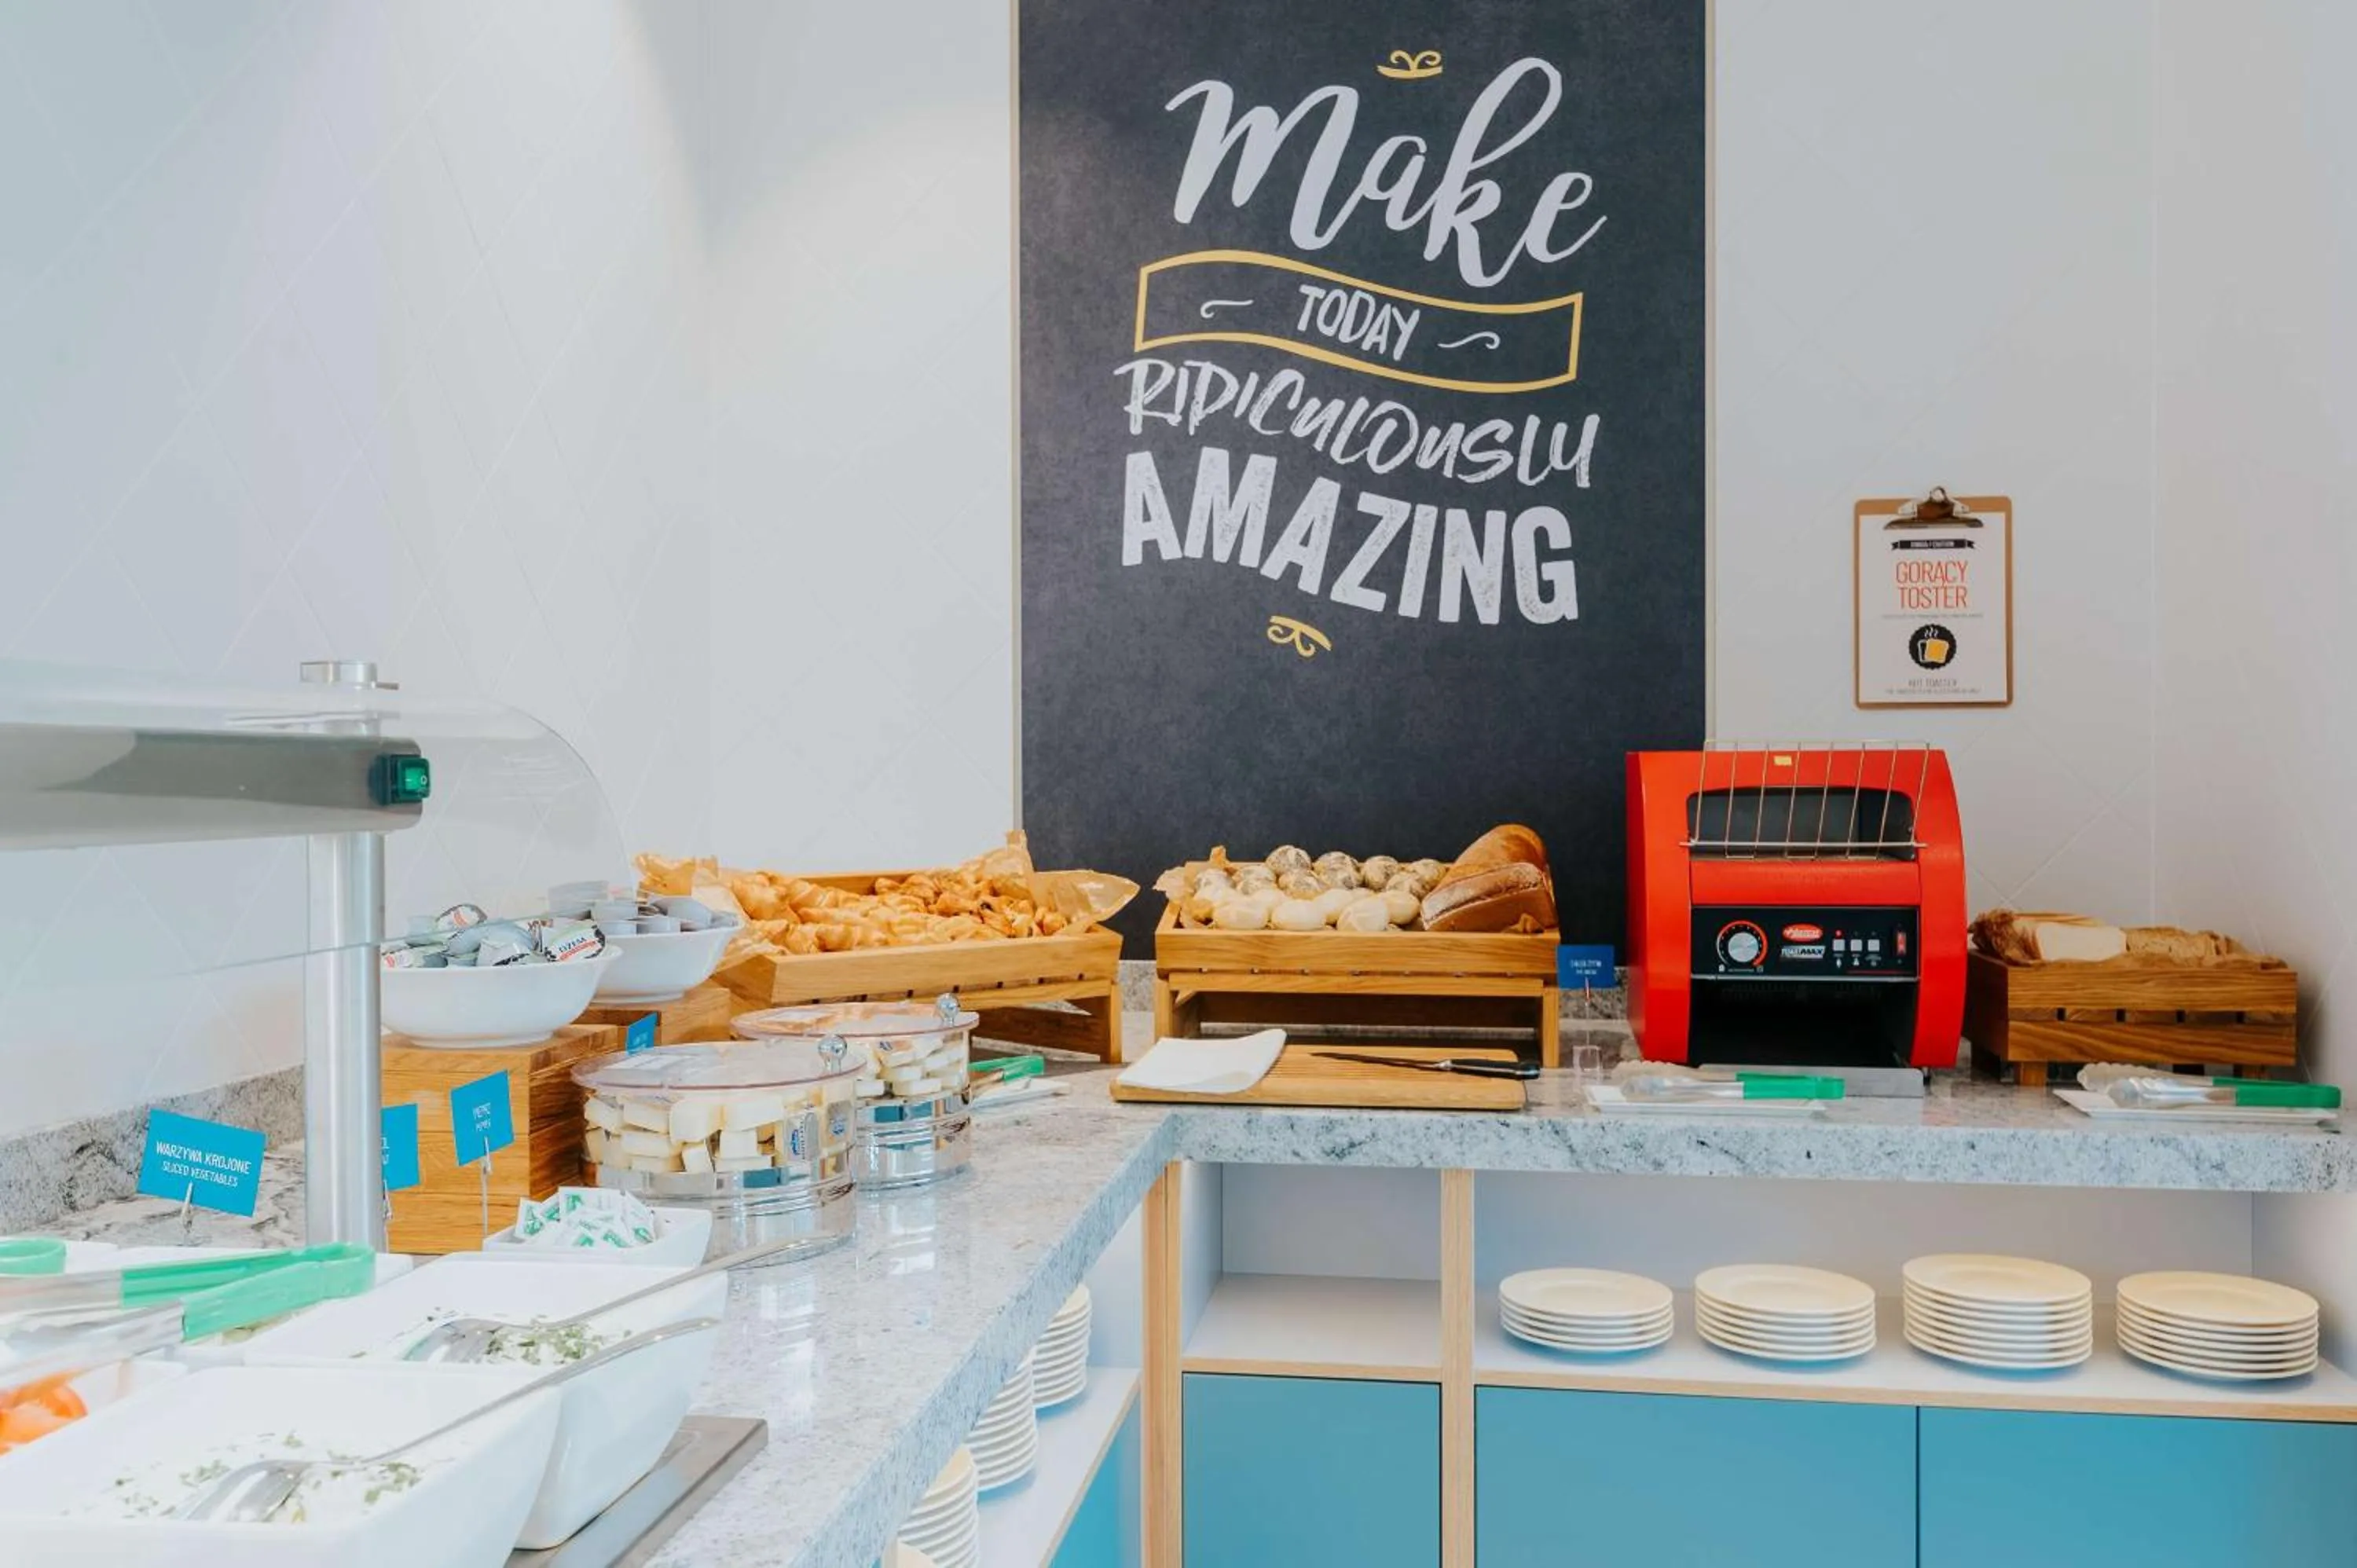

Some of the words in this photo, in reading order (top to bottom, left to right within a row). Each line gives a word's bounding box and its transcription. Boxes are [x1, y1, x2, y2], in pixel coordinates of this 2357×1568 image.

[1165, 58, 1606, 287] Make
[1298, 284, 1420, 361] TODAY
[1113, 358, 1600, 488] RIDICULOUSLY
[1122, 446, 1578, 625] AMAZING
[1898, 587, 1968, 609] TOSTER
[156, 1141, 202, 1164] WARZYWA
[203, 1152, 252, 1175] KROJONE
[163, 1160, 189, 1176] SLICED
[190, 1167, 239, 1188] VEGETABLES
